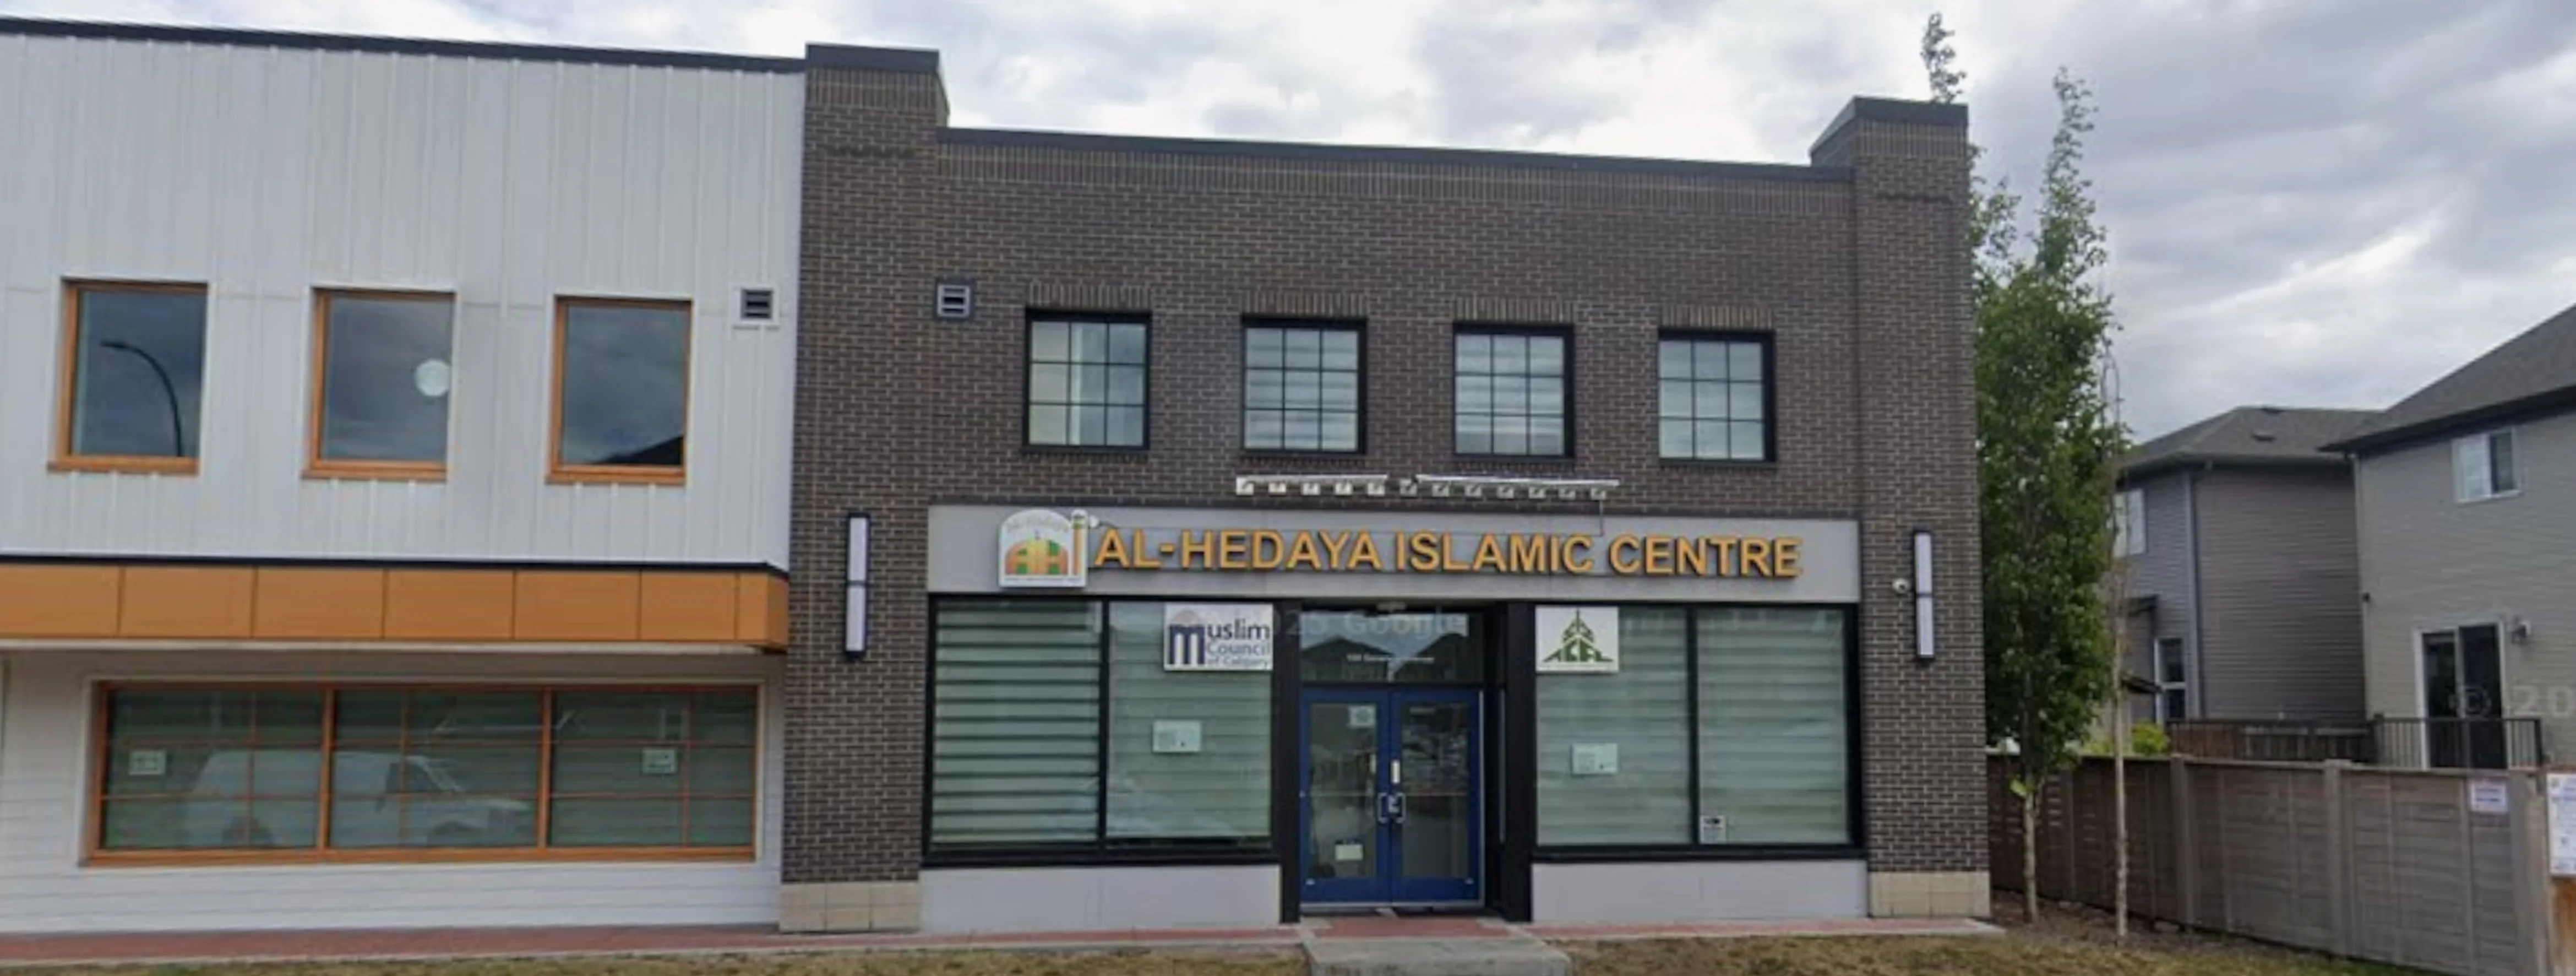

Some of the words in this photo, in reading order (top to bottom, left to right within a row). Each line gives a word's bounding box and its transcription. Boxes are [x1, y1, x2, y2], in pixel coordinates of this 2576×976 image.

[1094, 528, 1382, 570] AL-HEDAYA
[1396, 530, 1593, 572] ISLAMIC
[1610, 535, 1803, 577] CENTRE
[1207, 641, 1271, 656] Council
